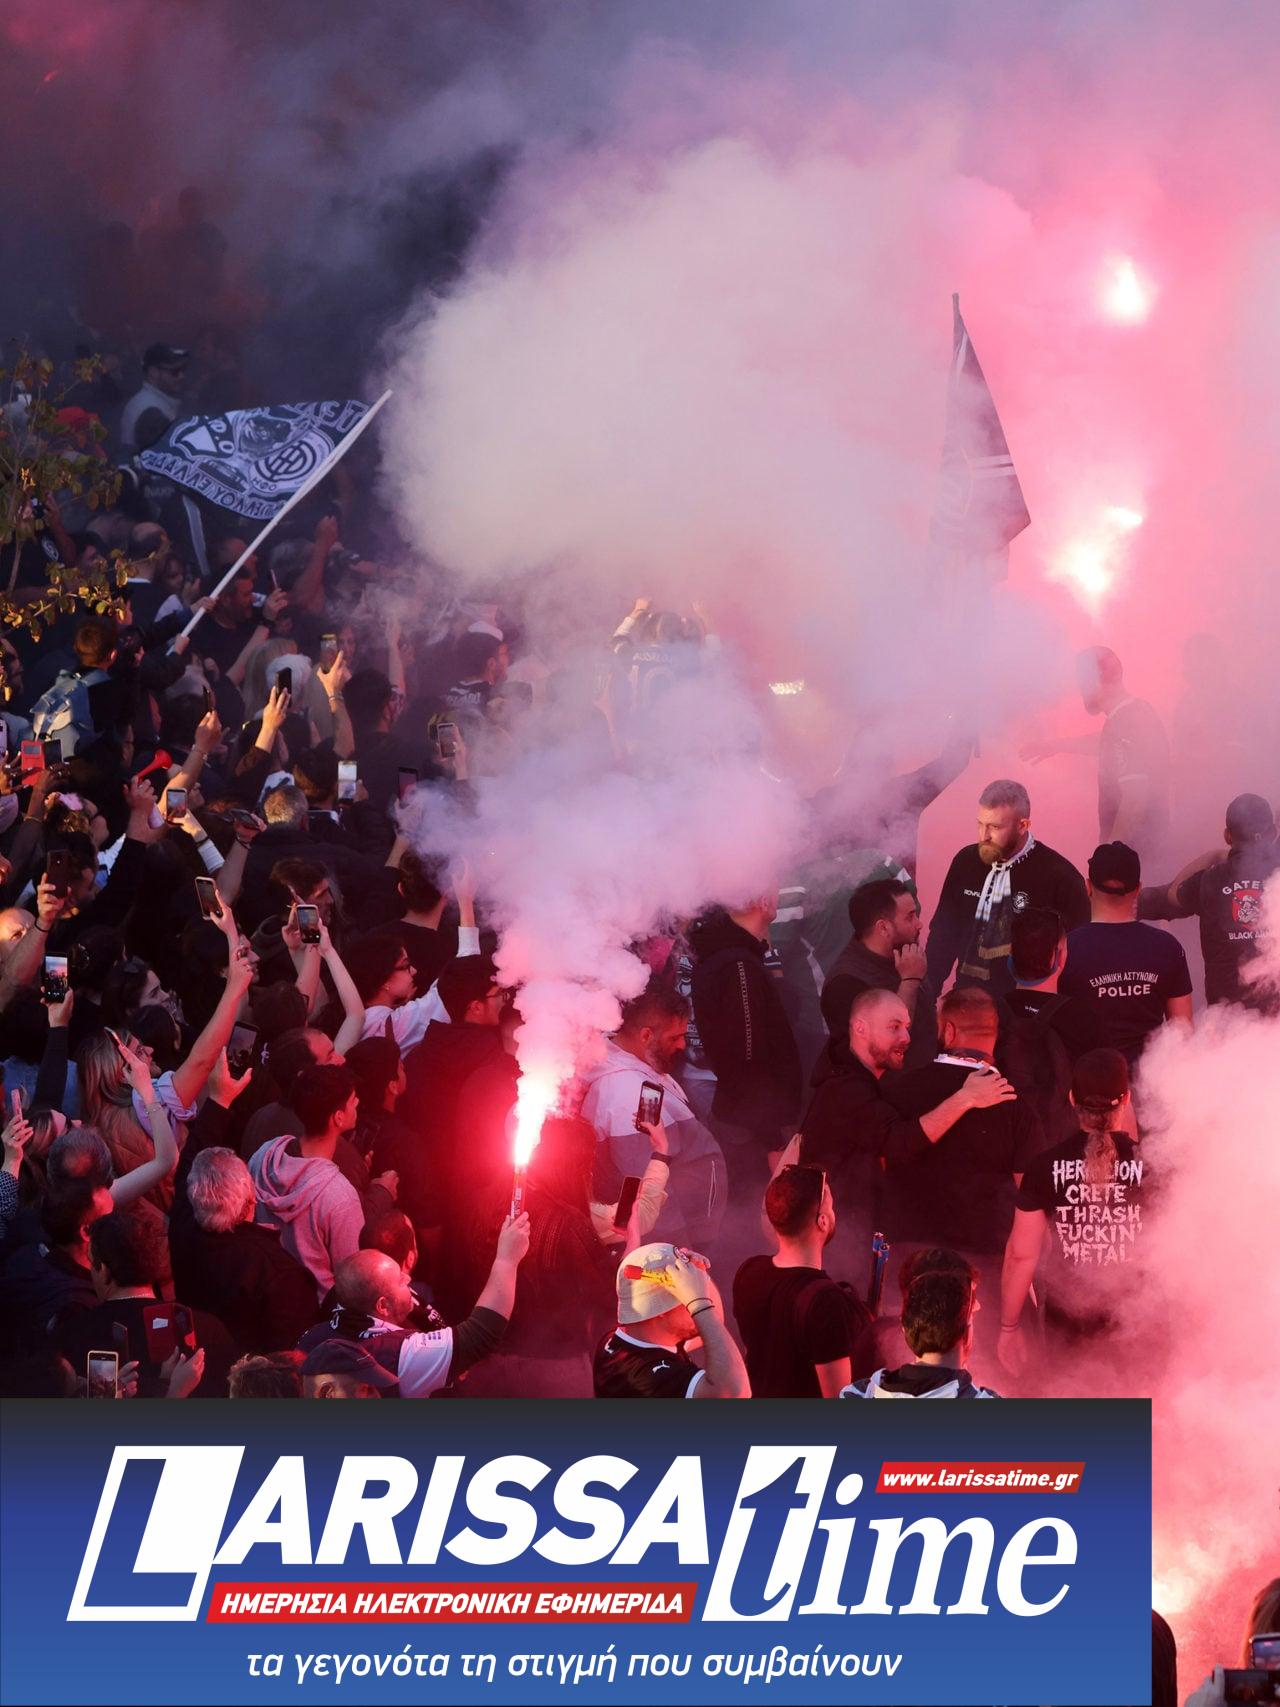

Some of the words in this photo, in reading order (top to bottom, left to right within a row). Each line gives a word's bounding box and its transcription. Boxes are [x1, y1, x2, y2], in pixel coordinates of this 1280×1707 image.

[1228, 932, 1253, 940] BLACK
[1089, 972, 1122, 988] ΕΛΛΗΝΙΚΗ
[1123, 971, 1159, 984] ΑΣΤΥΝΟΜΙΑ
[1098, 984, 1151, 998] POLICE
[1052, 1159, 1143, 1193] HERION
[1065, 1182, 1127, 1204] CRETE
[1056, 1204, 1141, 1224] THRASH
[1056, 1222, 1143, 1246] FUCKIN'
